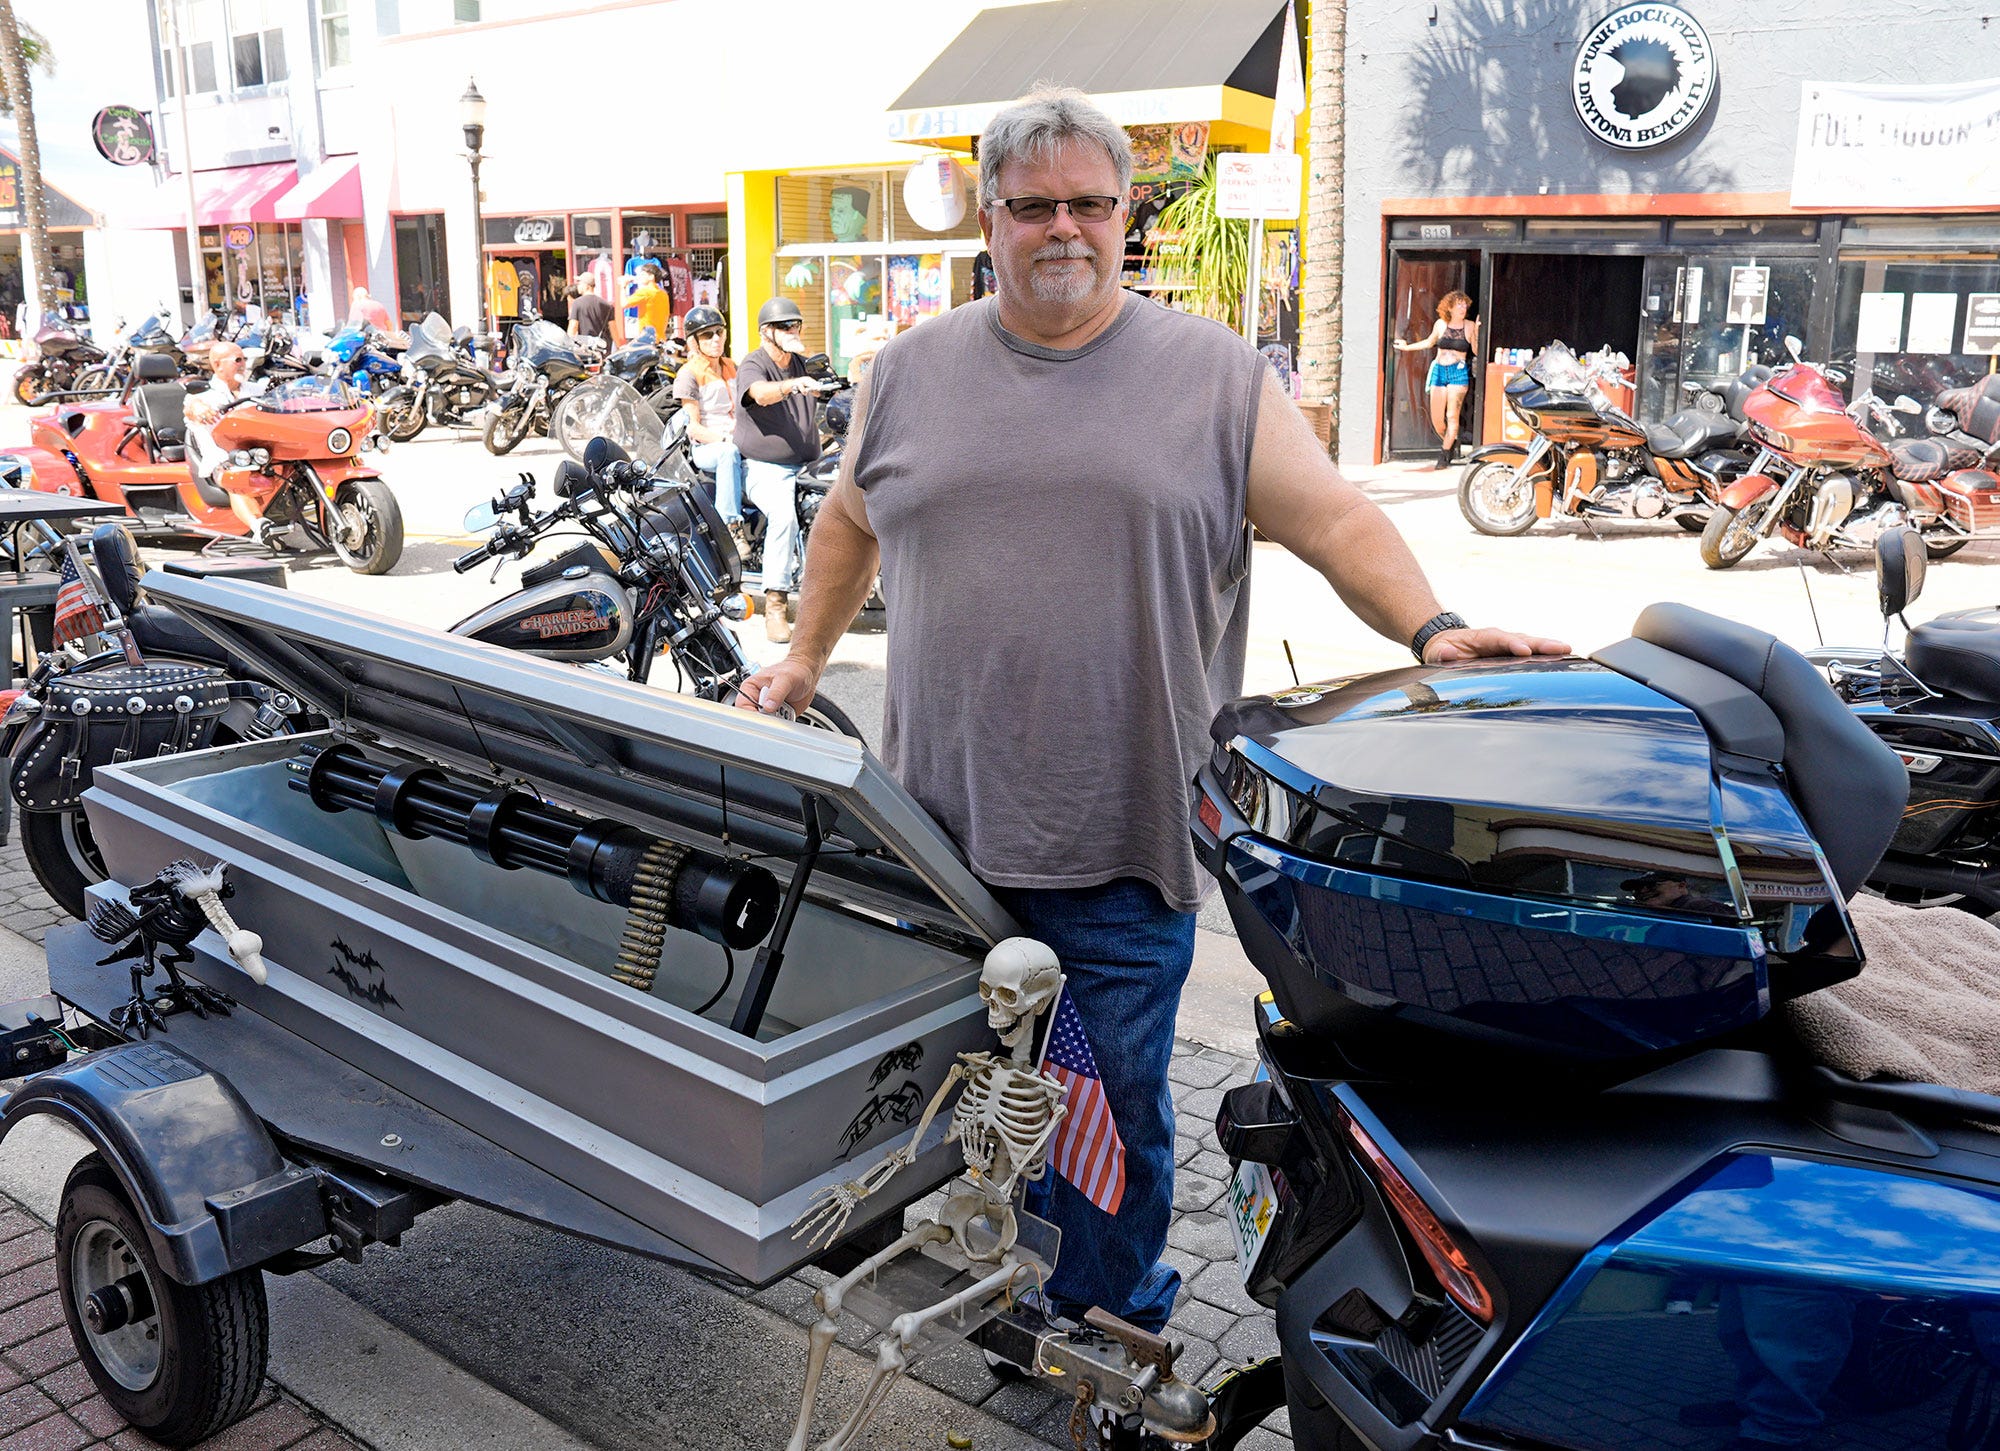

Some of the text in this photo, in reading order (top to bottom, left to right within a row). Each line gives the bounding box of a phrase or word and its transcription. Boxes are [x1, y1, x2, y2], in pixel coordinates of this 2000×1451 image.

[1579, 8, 1706, 74] PUNK ROCK PIZZA
[1578, 80, 1632, 142] DAYTONA
[1637, 101, 1694, 142] BEACH
[1811, 111, 1864, 148] FULL
[515, 221, 550, 241] OPEN
[1424, 227, 1448, 240] 819
[532, 611, 583, 628] HARLEY
[540, 618, 608, 638] DAVIDSON
